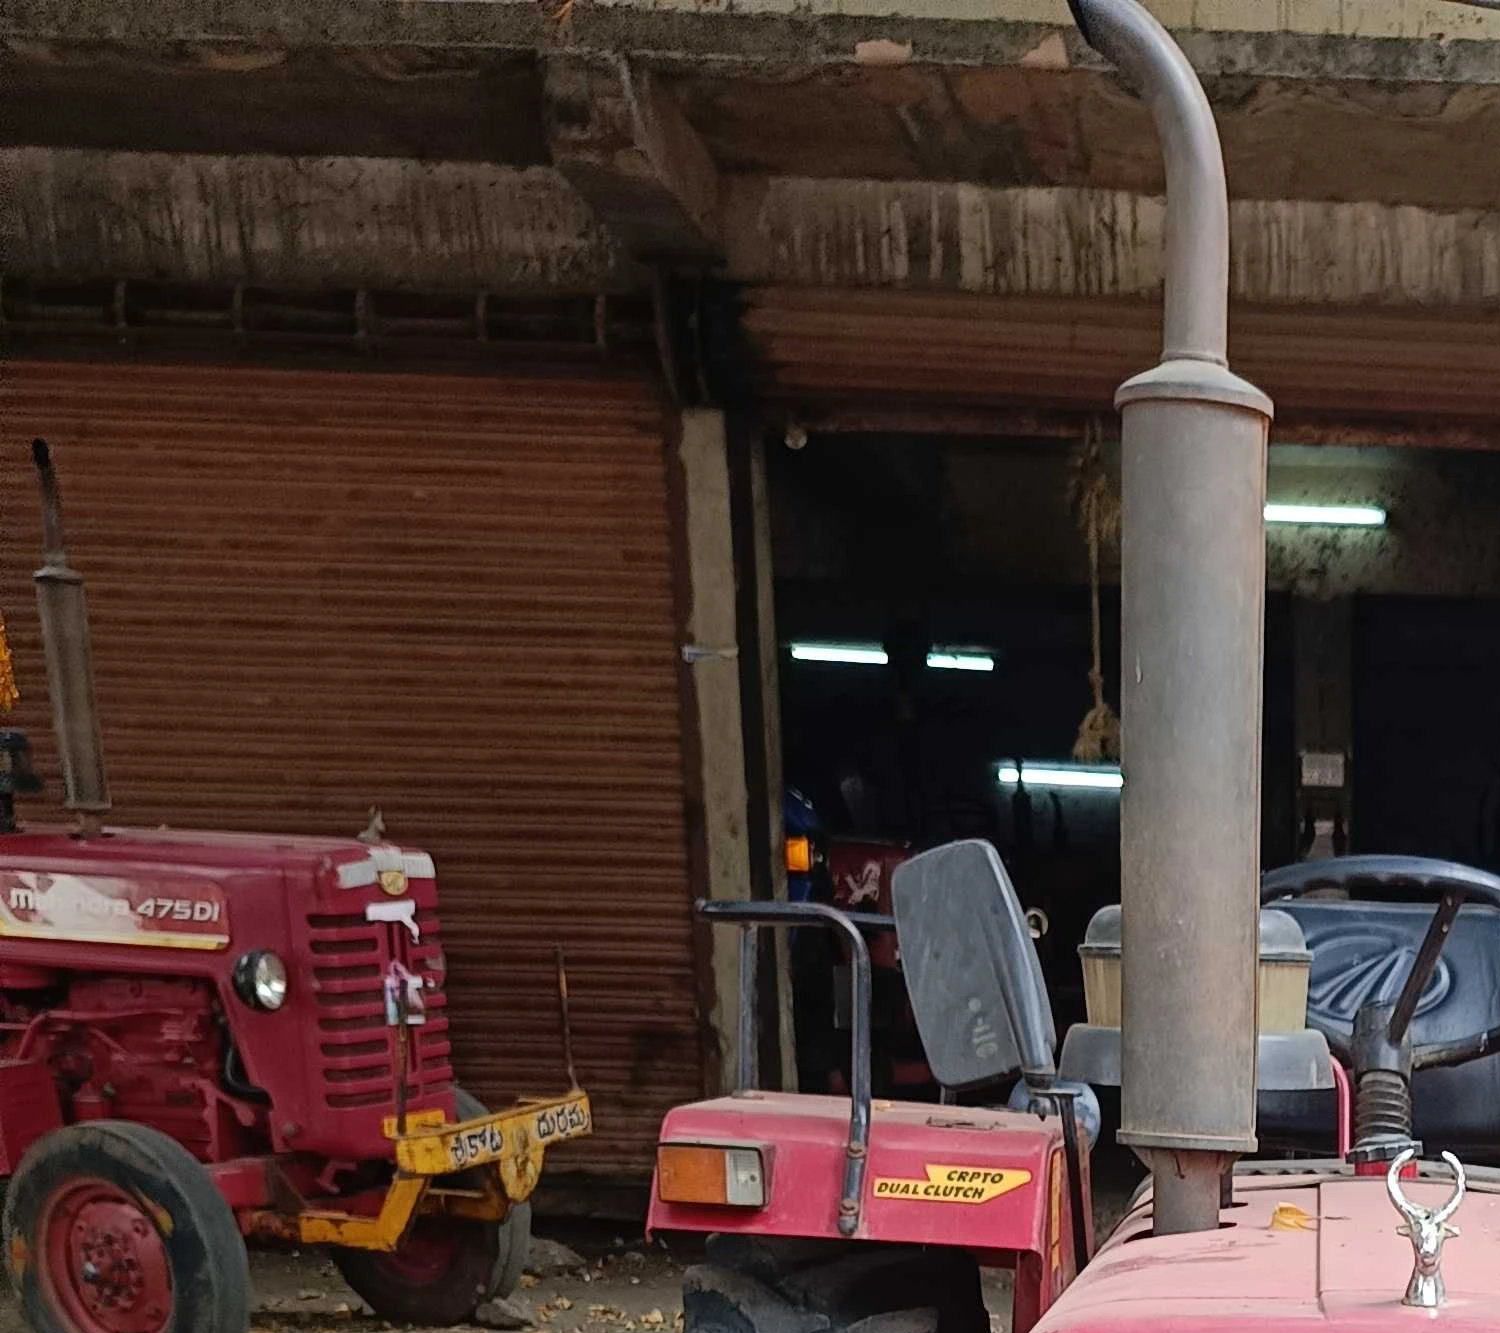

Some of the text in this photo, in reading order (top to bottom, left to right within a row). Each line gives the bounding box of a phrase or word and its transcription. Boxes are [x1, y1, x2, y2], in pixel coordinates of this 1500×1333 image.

[137, 898, 220, 923] 475DI
[946, 1170, 1004, 1184] CRPTO
[877, 1182, 985, 1200] DUAL CLUTCH
